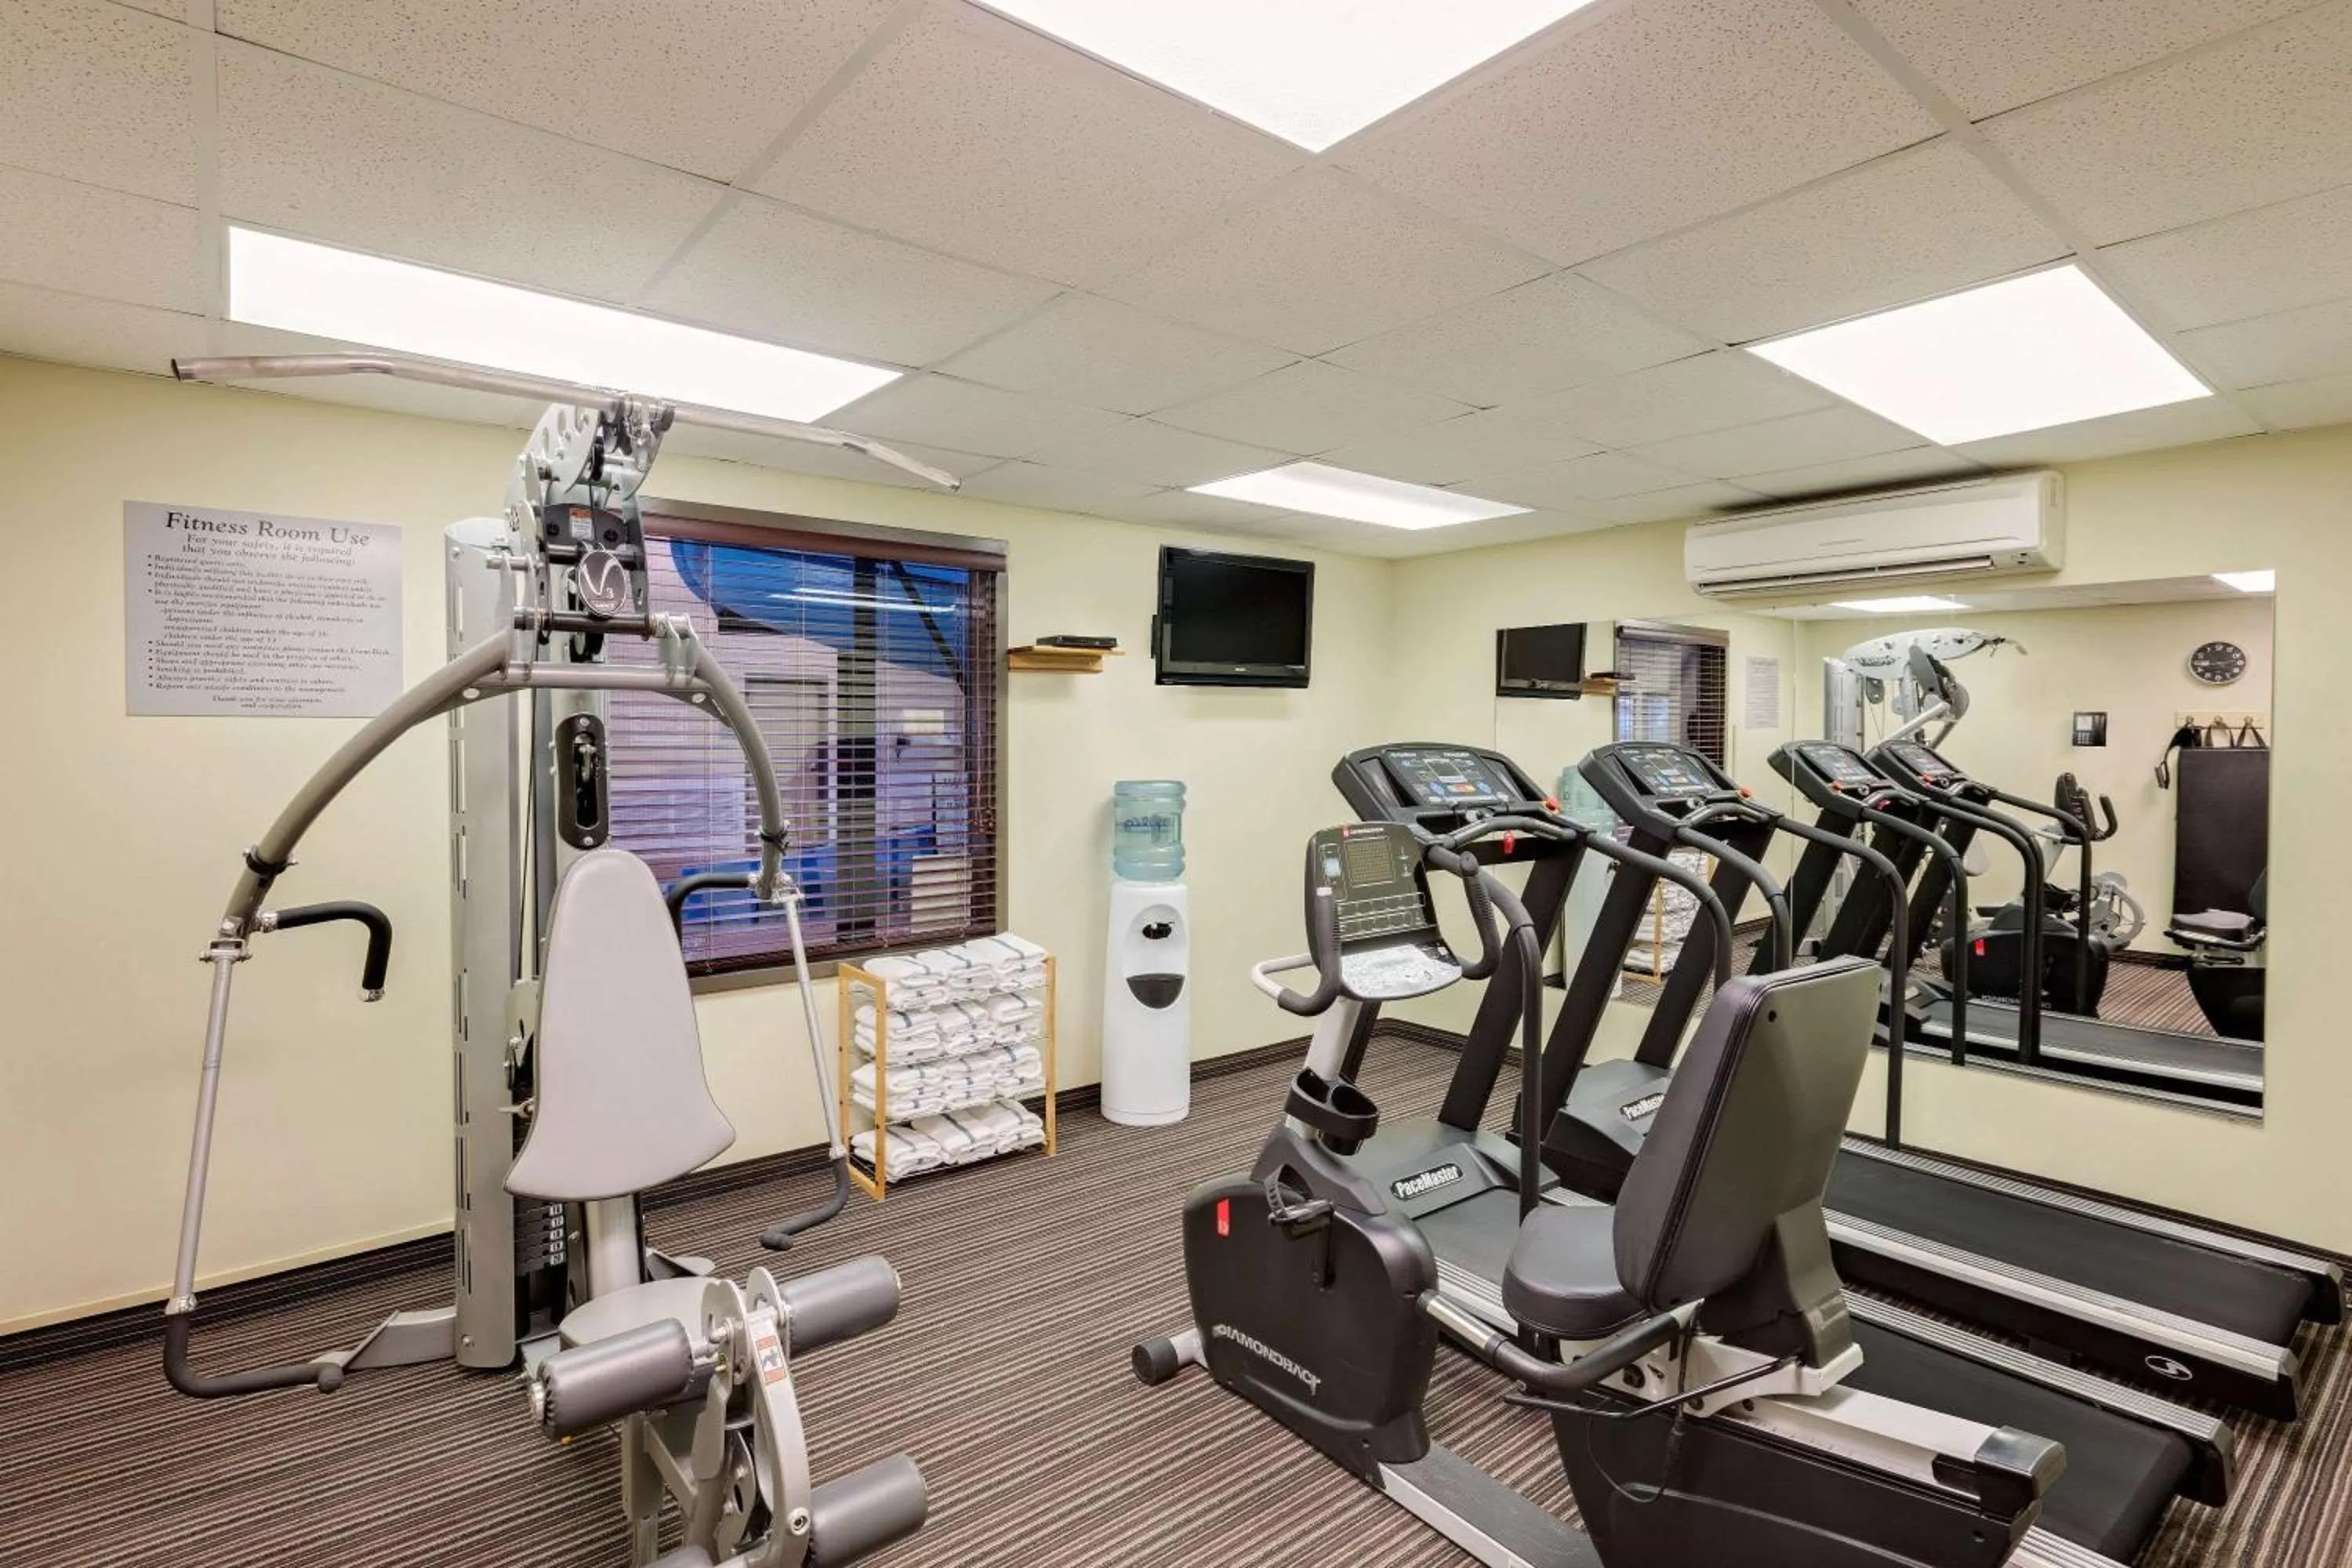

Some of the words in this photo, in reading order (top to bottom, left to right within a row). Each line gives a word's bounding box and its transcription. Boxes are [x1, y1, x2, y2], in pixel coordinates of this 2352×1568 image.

[165, 511, 248, 535] Fitness
[258, 520, 321, 541] Room
[330, 527, 370, 546] Use
[1395, 1166, 1459, 1198] PaceMaster
[1212, 1324, 1321, 1396] DIAMONDBACK
